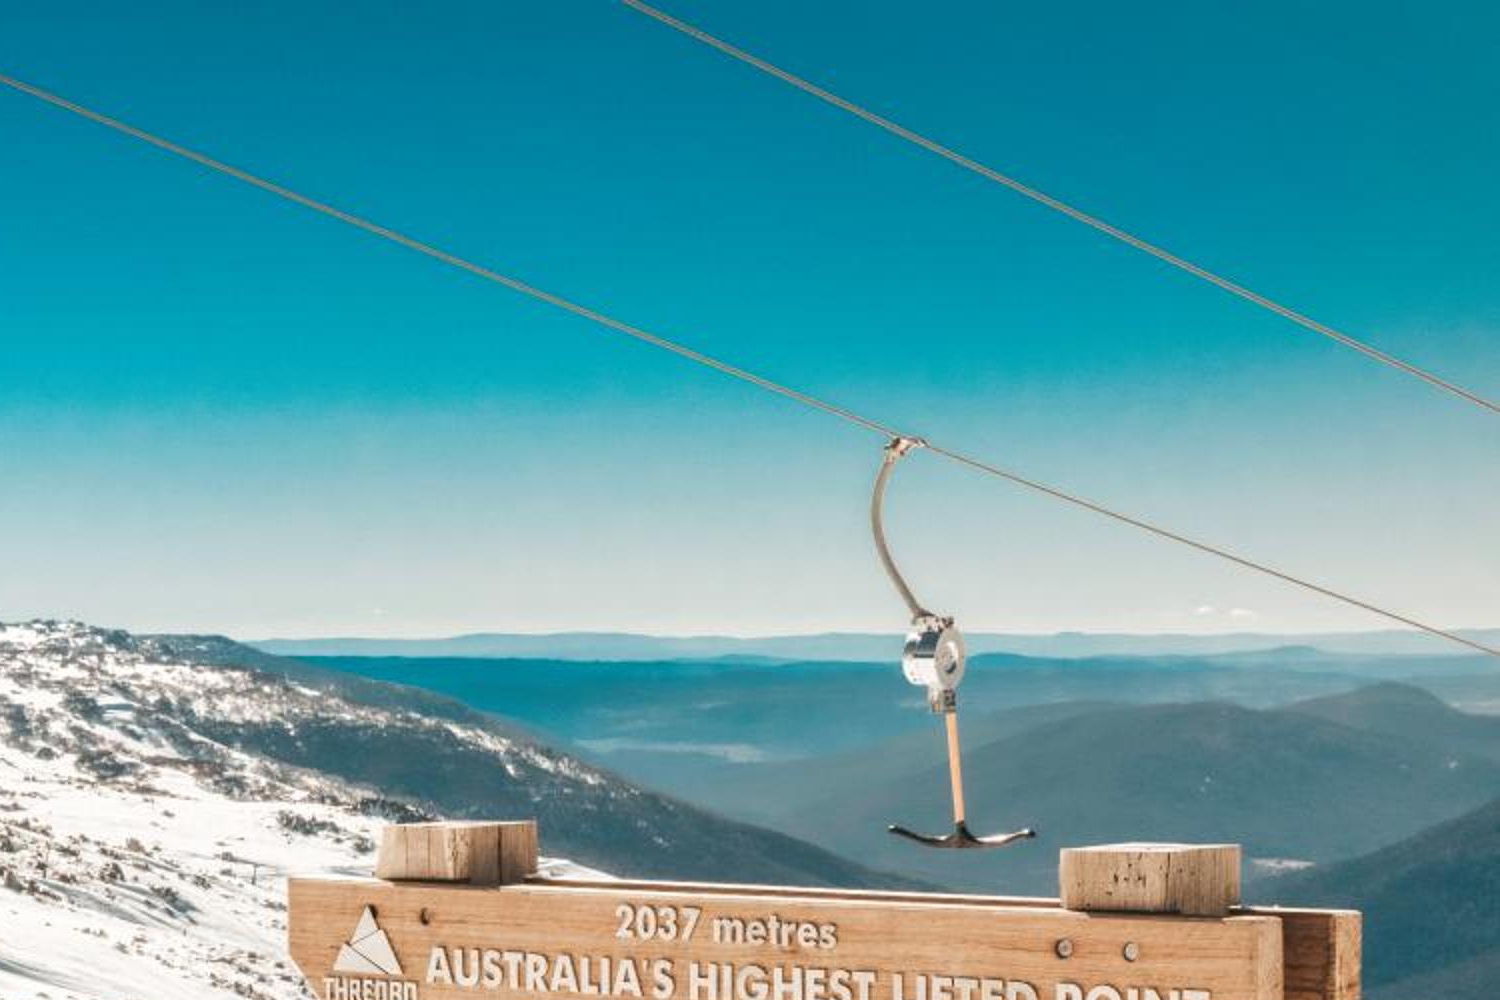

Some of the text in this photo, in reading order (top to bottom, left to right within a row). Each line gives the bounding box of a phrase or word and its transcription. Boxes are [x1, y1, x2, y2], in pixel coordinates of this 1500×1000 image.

[615, 903, 837, 949] 2037 metres
[425, 946, 675, 999] AUSTRALIA'S
